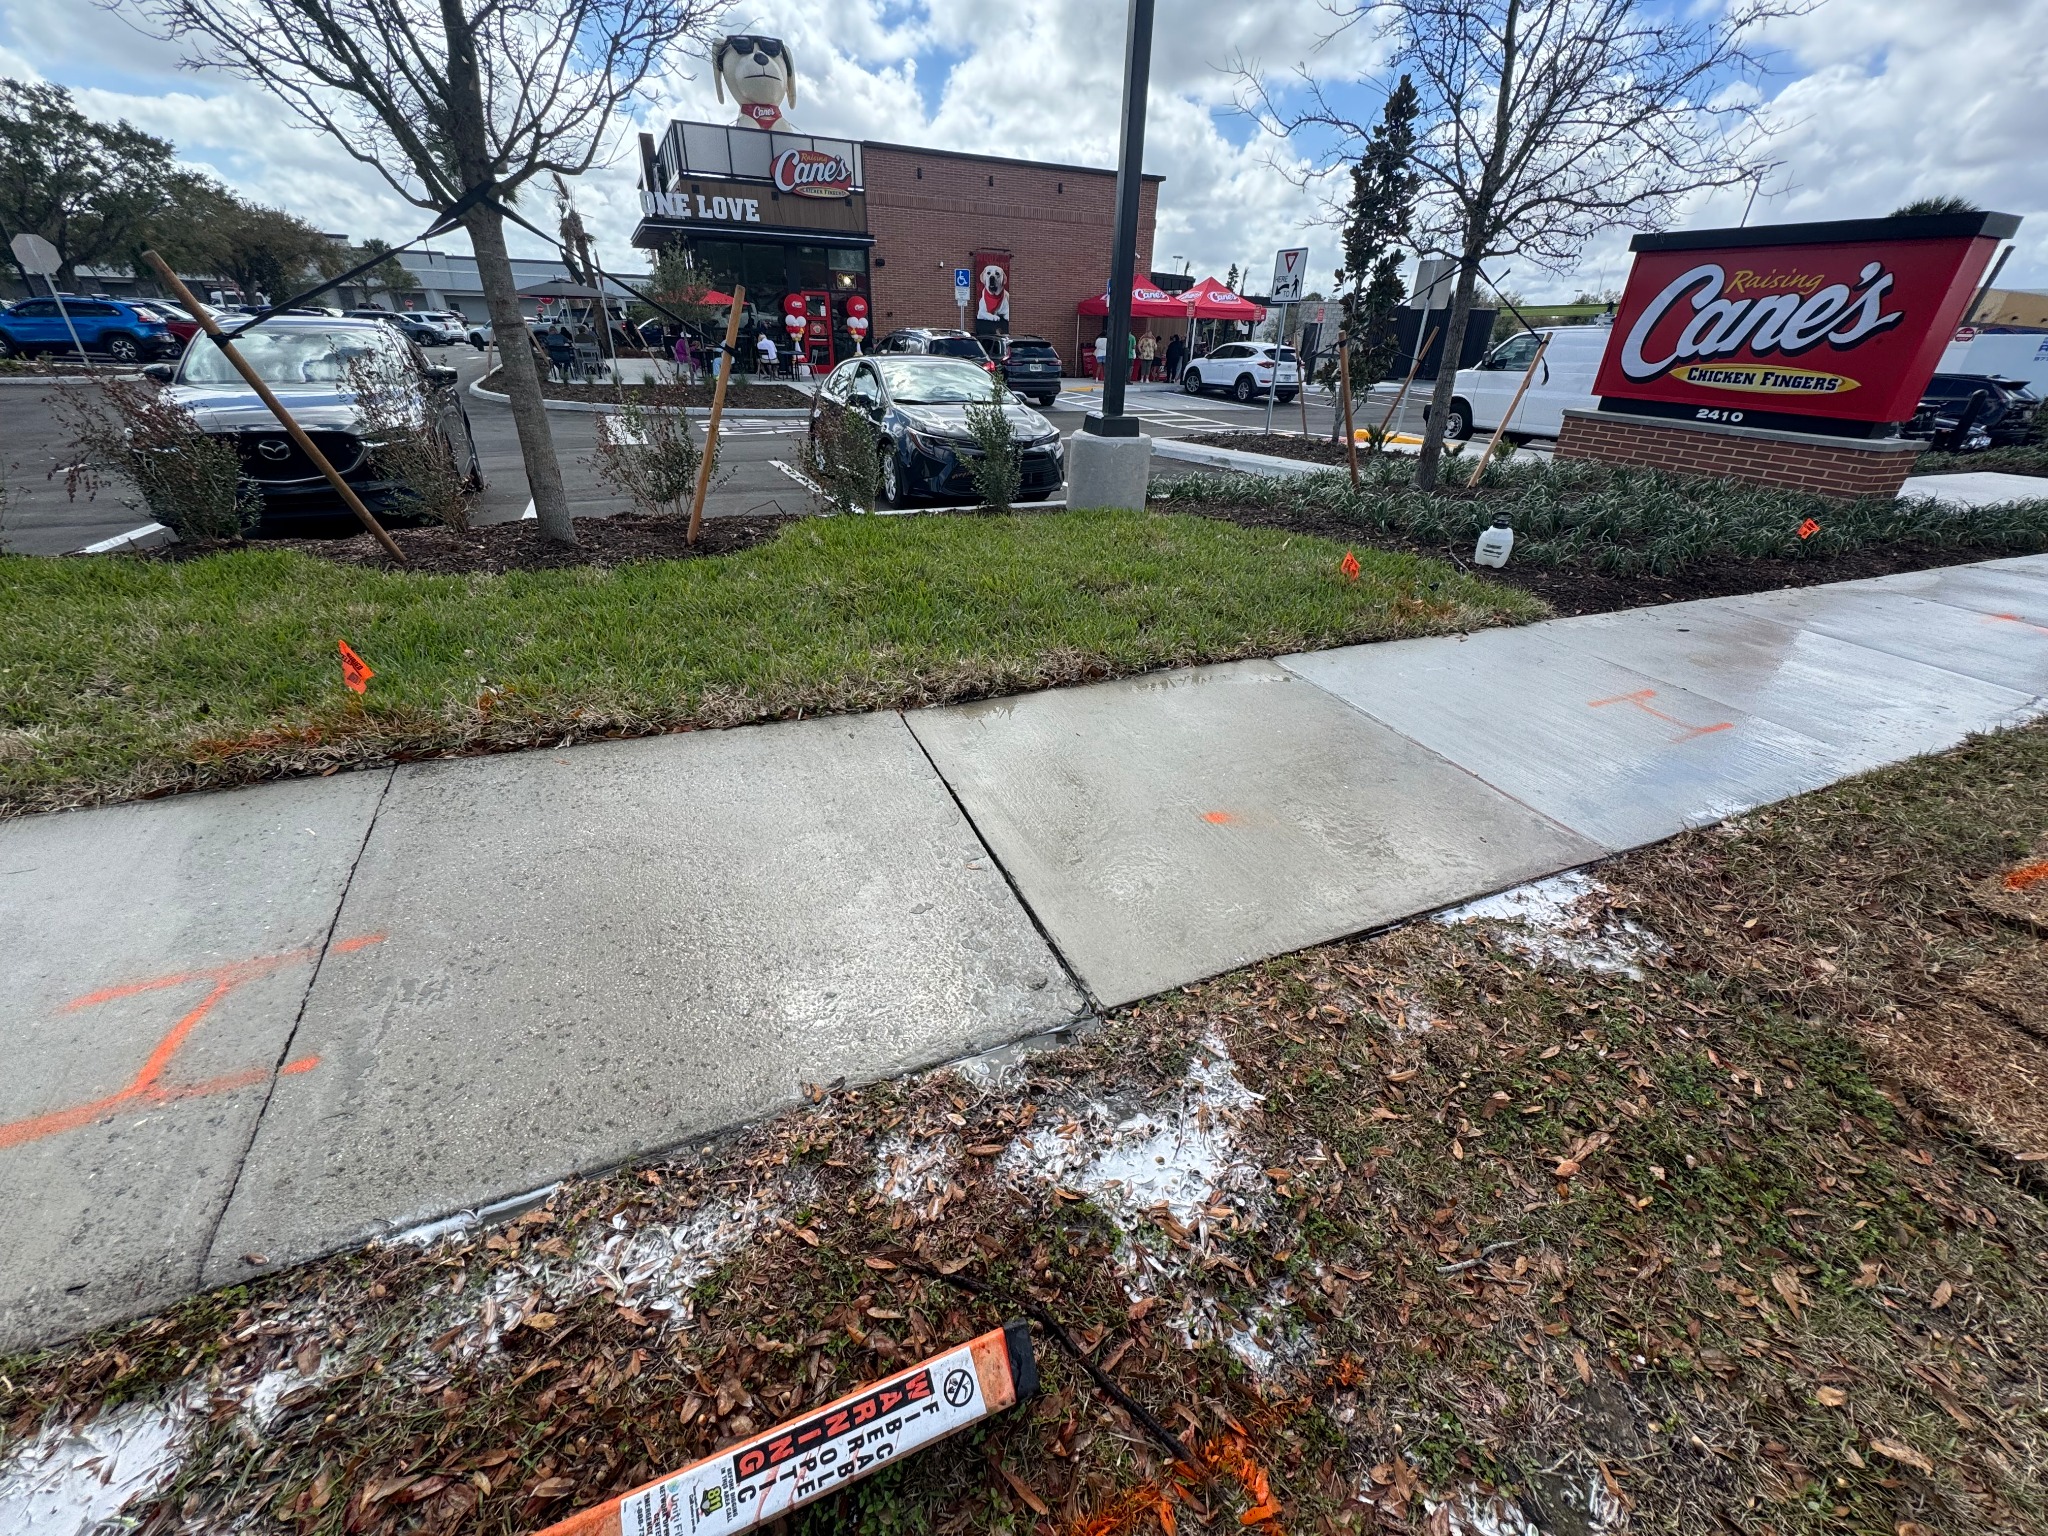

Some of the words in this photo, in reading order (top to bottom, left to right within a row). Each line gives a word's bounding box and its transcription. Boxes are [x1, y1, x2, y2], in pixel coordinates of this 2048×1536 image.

[775, 149, 851, 191] Cane's
[801, 153, 828, 164] Raising
[639, 190, 692, 218] ONE
[698, 194, 761, 223] LOVE
[1725, 268, 1825, 296] Raising
[1620, 261, 1903, 379] Cane's
[1687, 367, 1759, 386] CHICKEN
[1760, 370, 1841, 392] FINGERS
[1696, 408, 1744, 423] 2410
[738, 1371, 932, 1477] WARNING
[847, 1401, 940, 1453] FIBER
[737, 1447, 838, 1504] OPTIC
[797, 1443, 894, 1499] CABLE
[644, 1492, 653, 1535] EMERGENCY
[660, 1484, 668, 1518] NETWORK
[671, 1493, 681, 1522] Uniti
[707, 1487, 722, 1511] 811
